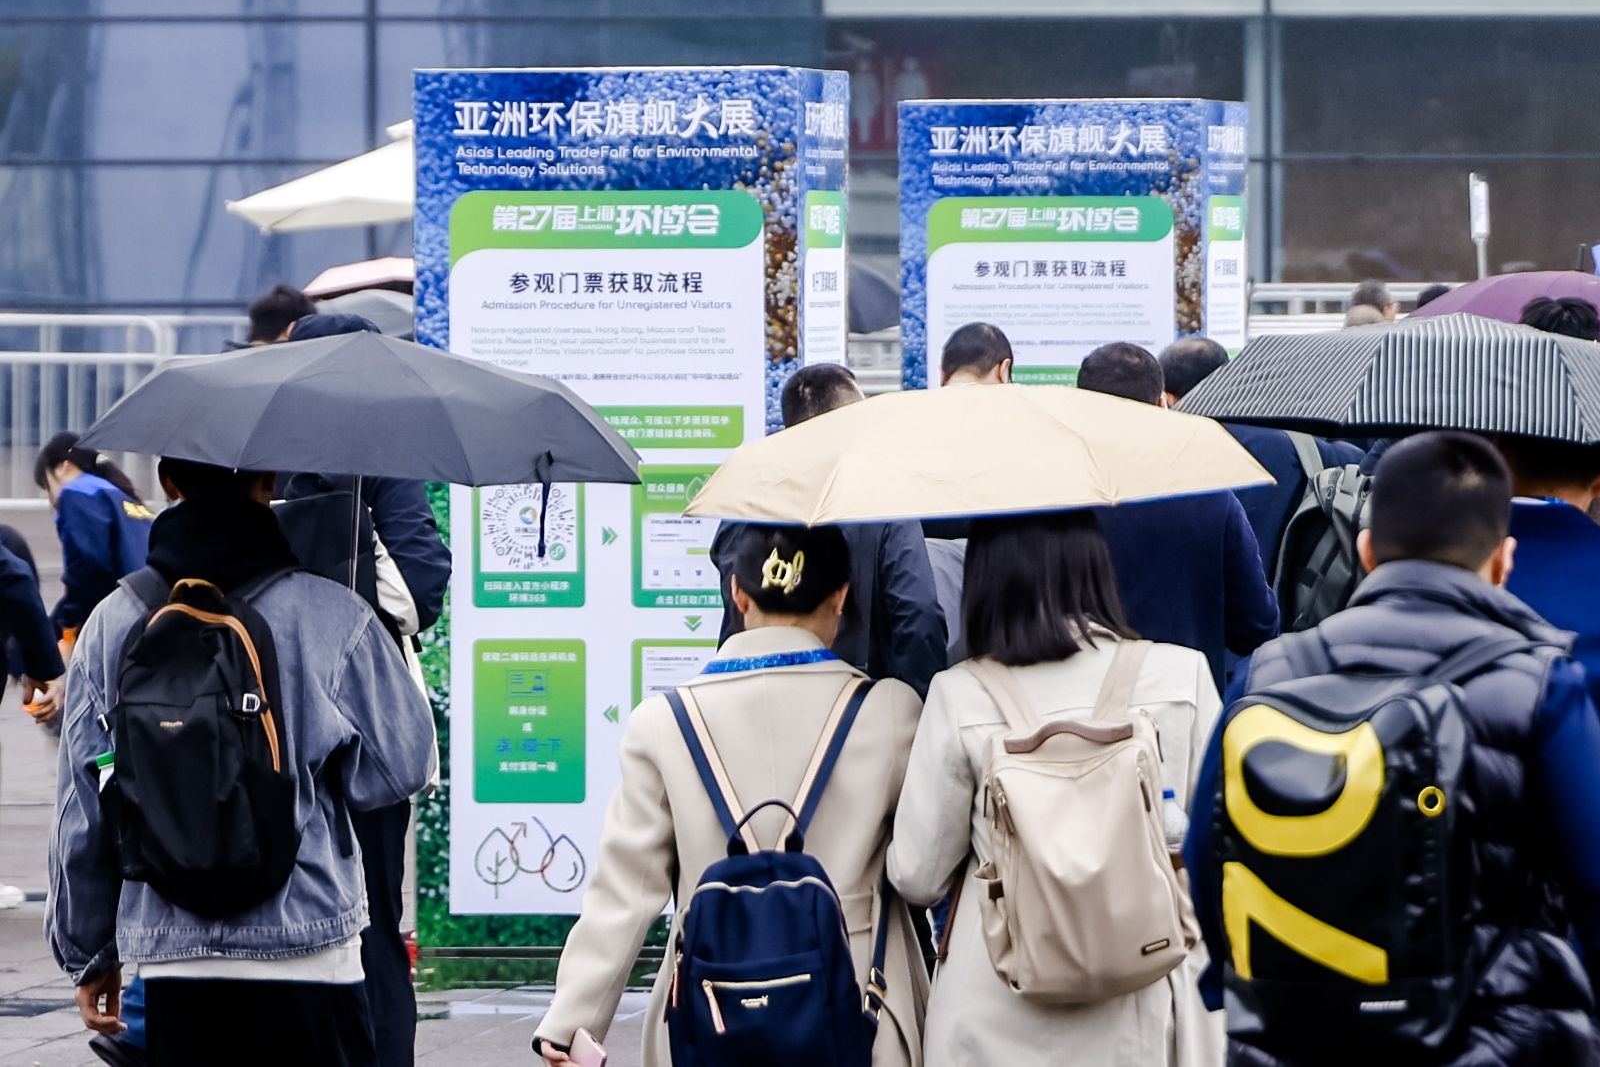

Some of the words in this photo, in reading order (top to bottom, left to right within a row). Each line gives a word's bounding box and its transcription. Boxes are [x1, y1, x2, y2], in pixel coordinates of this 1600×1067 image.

[454, 94, 755, 139] 亚洲环保旗舰大展
[929, 121, 1170, 156] 亚洲环保旗舰大展
[498, 146, 555, 161] Leading
[558, 146, 599, 158] Trade
[600, 145, 628, 157] Fair
[632, 145, 654, 157] for
[656, 144, 758, 158] Environmental
[456, 163, 535, 178] Technology
[538, 162, 605, 175] Solutions
[964, 162, 1009, 174] Leading
[1012, 161, 1043, 172] Trade
[1070, 161, 1086, 171] for
[1088, 160, 1169, 171] Environmental
[933, 175, 994, 187] Technology
[997, 174, 1049, 185] Solutions
[974, 260, 1127, 277] 参观门票获取流程
[508, 271, 704, 294] 参观门票获取流程
[481, 300, 537, 310] Admission
[539, 300, 595, 310] Procedure
[598, 300, 614, 310] for
[616, 300, 687, 312] Unregistered
[690, 300, 732, 310] Visitors
